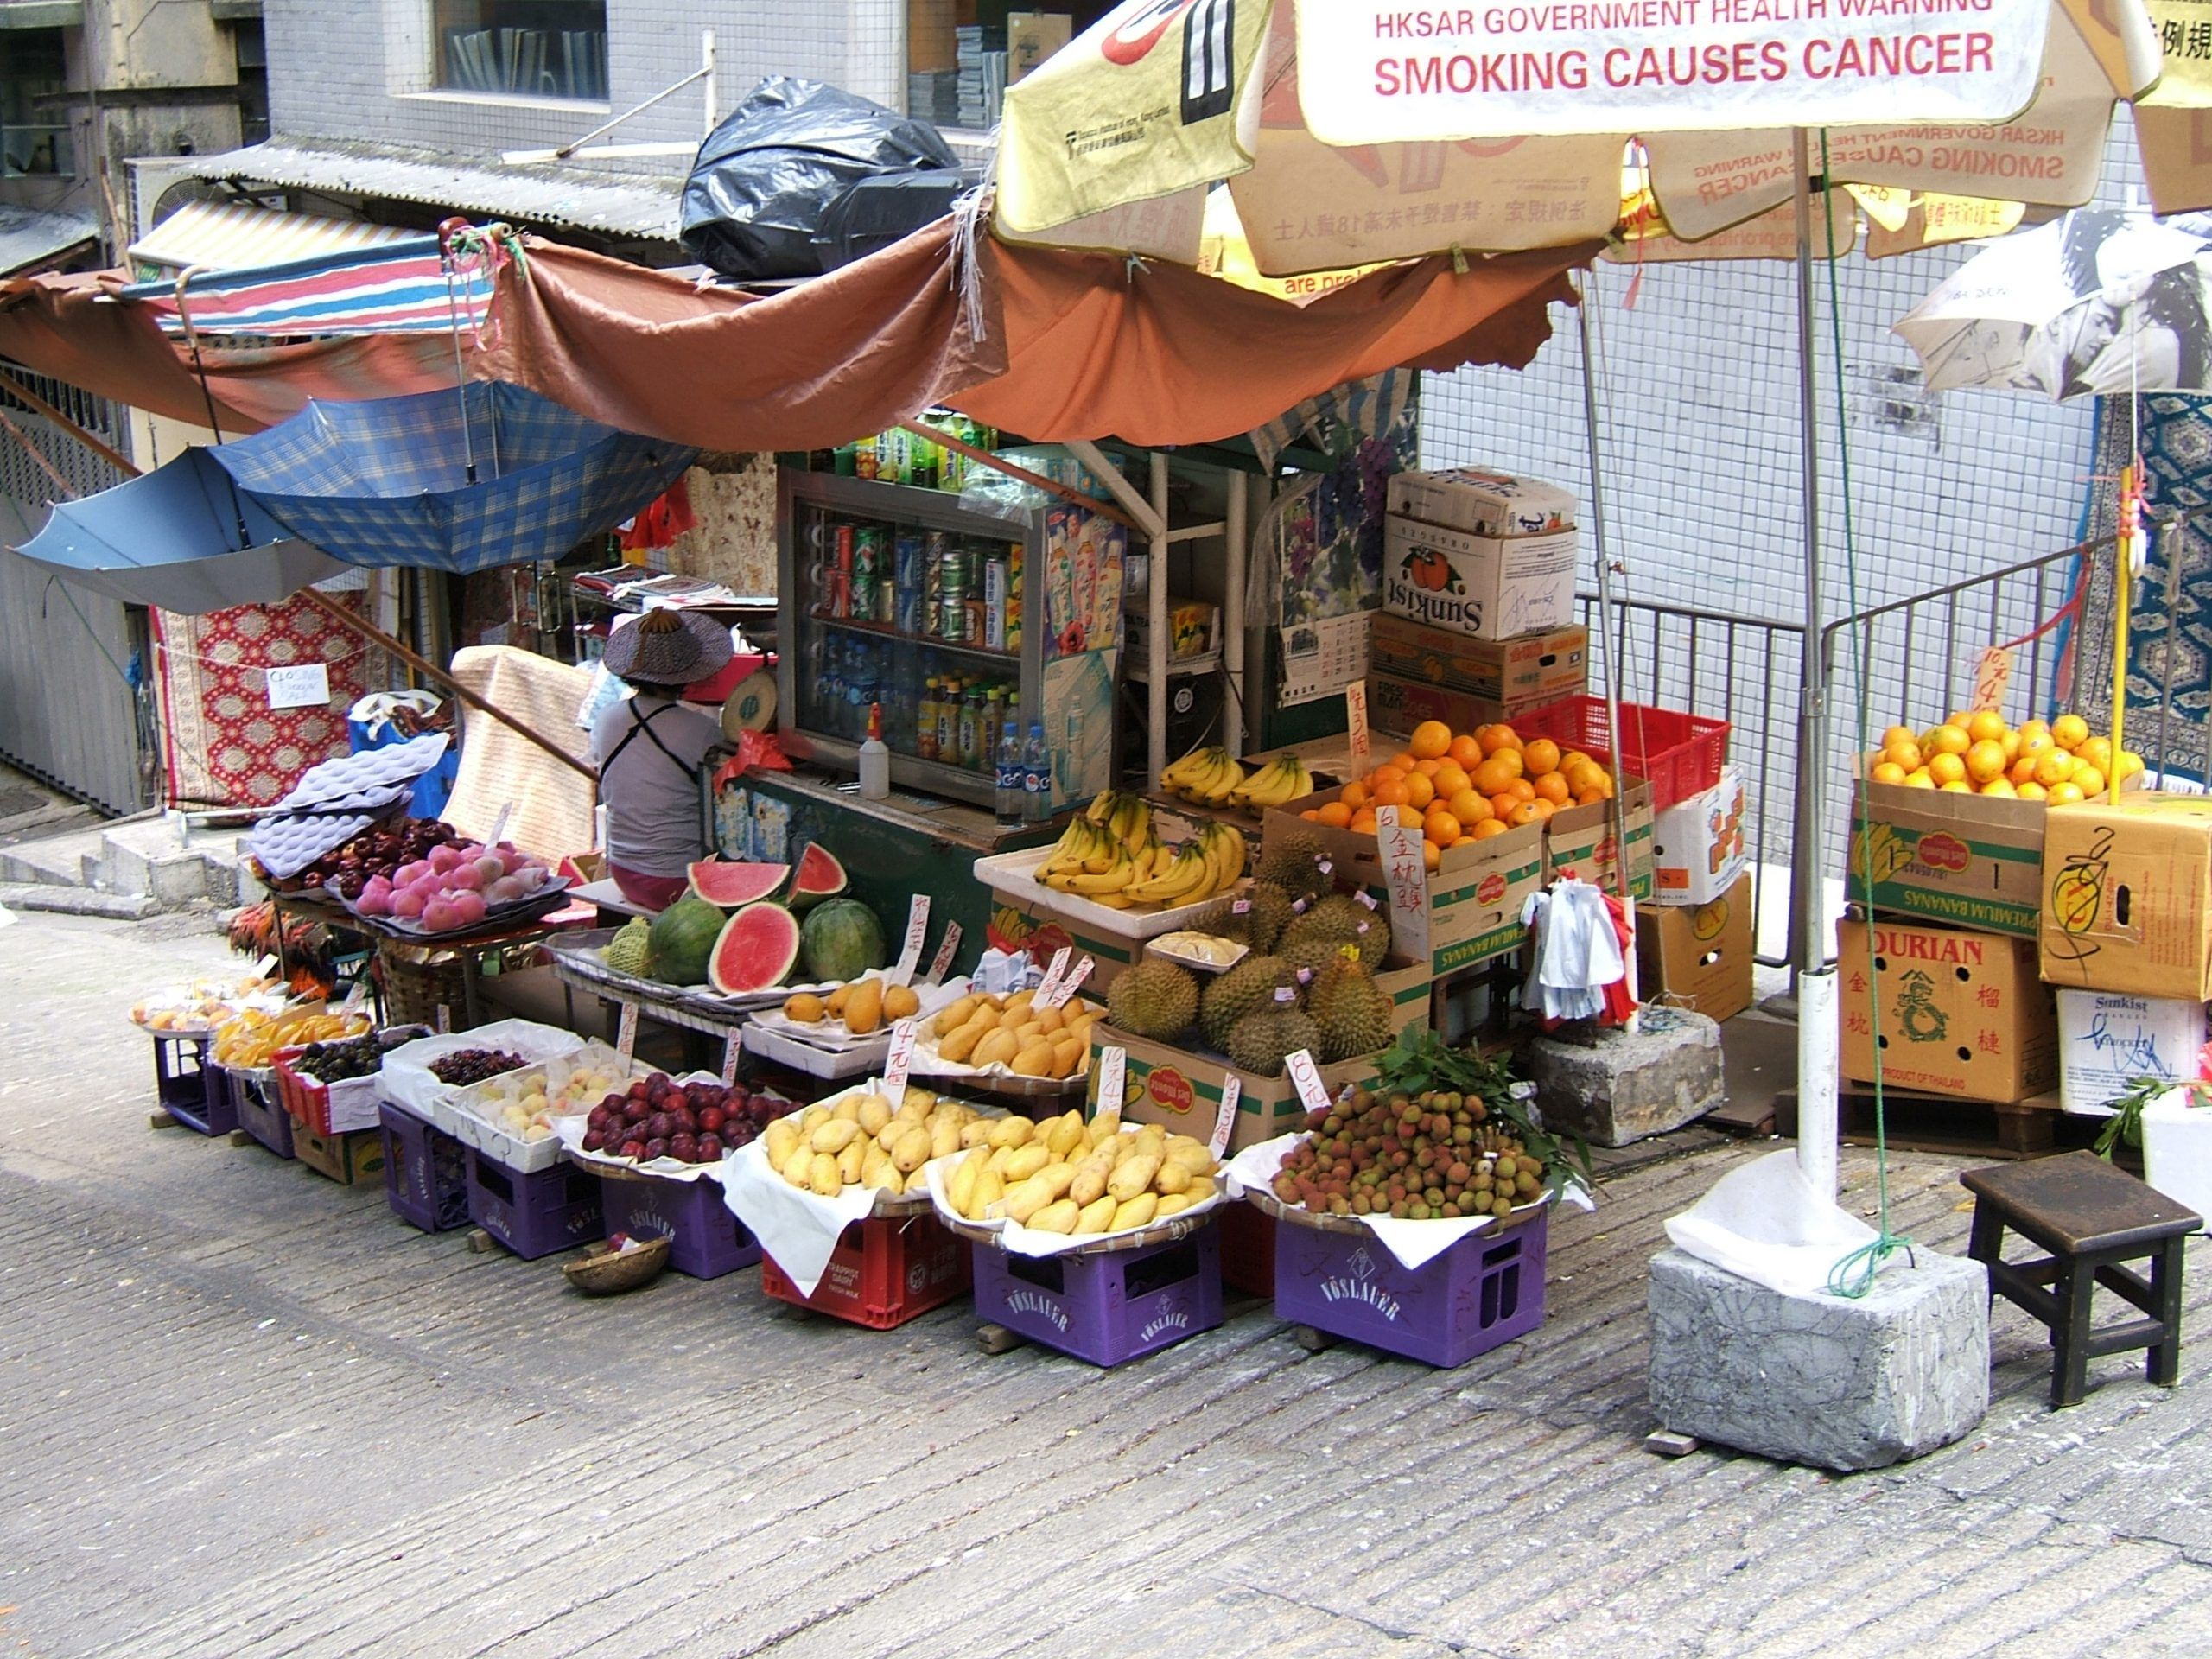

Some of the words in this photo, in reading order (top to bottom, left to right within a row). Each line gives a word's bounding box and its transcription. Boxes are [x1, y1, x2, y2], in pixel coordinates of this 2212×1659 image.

[1375, 11, 1472, 39] HKSAR
[1484, 1, 1700, 35] GOVERNMENT
[1711, 0, 1827, 23] HEALTH
[1375, 50, 1588, 96] SMOKING
[1603, 41, 1789, 87] CAUSES
[1802, 31, 1994, 79] CANCER
[1285, 276, 1316, 295] are
[1389, 577, 1482, 632] Sunkist
[1696, 902, 1722, 931] CX
[1904, 890, 1970, 918] BANANAS
[1971, 906, 2037, 929] PREMIUM
[1440, 938, 1490, 966] BANANAS
[1866, 930, 1983, 965] DURIAN
[1847, 970, 1870, 1036] 金枕
[2094, 996, 2149, 1013] Sunkist
[1976, 983, 2002, 1055] 榴槤
[1918, 1072, 1929, 1083] OF
[1176, 1089, 1192, 1105] Del
[1320, 1275, 1401, 1322] VÖSLAUER
